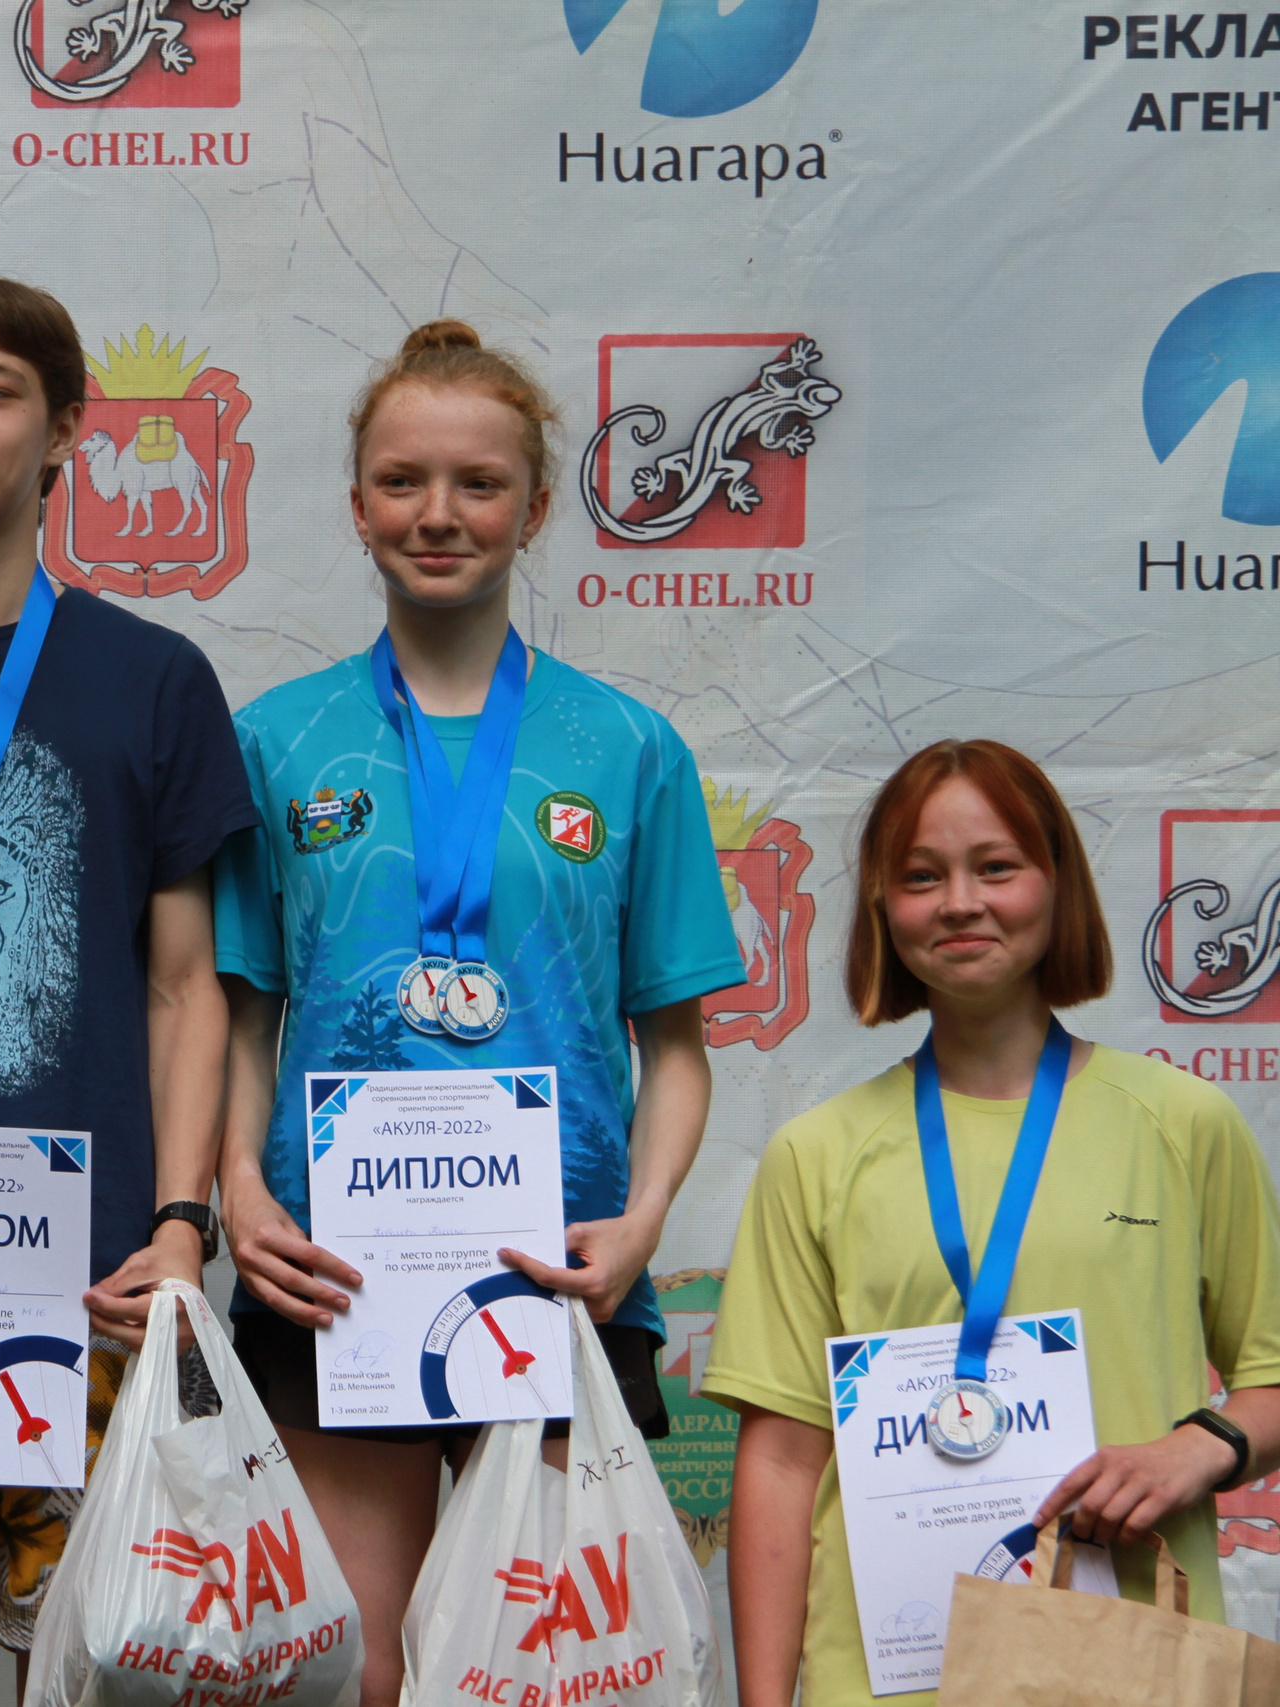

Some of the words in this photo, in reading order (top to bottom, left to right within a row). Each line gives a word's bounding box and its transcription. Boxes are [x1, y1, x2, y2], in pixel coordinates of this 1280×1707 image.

[13, 132, 250, 168] O-CHEL.RU
[576, 571, 814, 609] O-CHEL.RU
[366, 1084, 422, 1093] Традиционные
[424, 1083, 495, 1092] межрегиональные
[372, 1094, 427, 1104] соревнования
[439, 1093, 490, 1103] спортивному
[398, 1104, 464, 1113] ориентированию
[373, 1119, 491, 1136] «АКУЛЯ-2022»
[347, 1154, 520, 1197] ДИПЛОМ
[406, 1195, 464, 1205] награждается
[363, 1252, 374, 1260] за
[400, 1251, 432, 1260] место
[435, 1251, 448, 1259] по
[451, 1249, 489, 1261] группе
[385, 1263, 398, 1272] по
[400, 1262, 435, 1274] сумме
[437, 1261, 462, 1271] двух
[464, 1260, 492, 1270] дней
[452, 1297, 468, 1313] 330
[438, 1312, 453, 1329] 315
[428, 1332, 441, 1350] 300
[329, 1371, 364, 1379] Главный
[366, 1372, 390, 1380] судья
[330, 1383, 345, 1392] Д.В.
[347, 1382, 395, 1390] Мельников
[331, 1406, 343, 1415] 1-3
[345, 1406, 367, 1414] июля
[369, 1405, 389, 1413] 2022
[895, 1511, 907, 1520] за
[932, 1502, 965, 1515] место
[967, 1501, 982, 1511] по
[983, 1496, 1022, 1511] группе
[918, 1519, 932, 1529] по
[934, 1516, 968, 1528] сумме
[970, 1511, 996, 1524] двух
[998, 1507, 1026, 1520] дней
[117, 1640, 183, 1675] НАС
[519, 1647, 666, 1707] ВИРАЮТ
